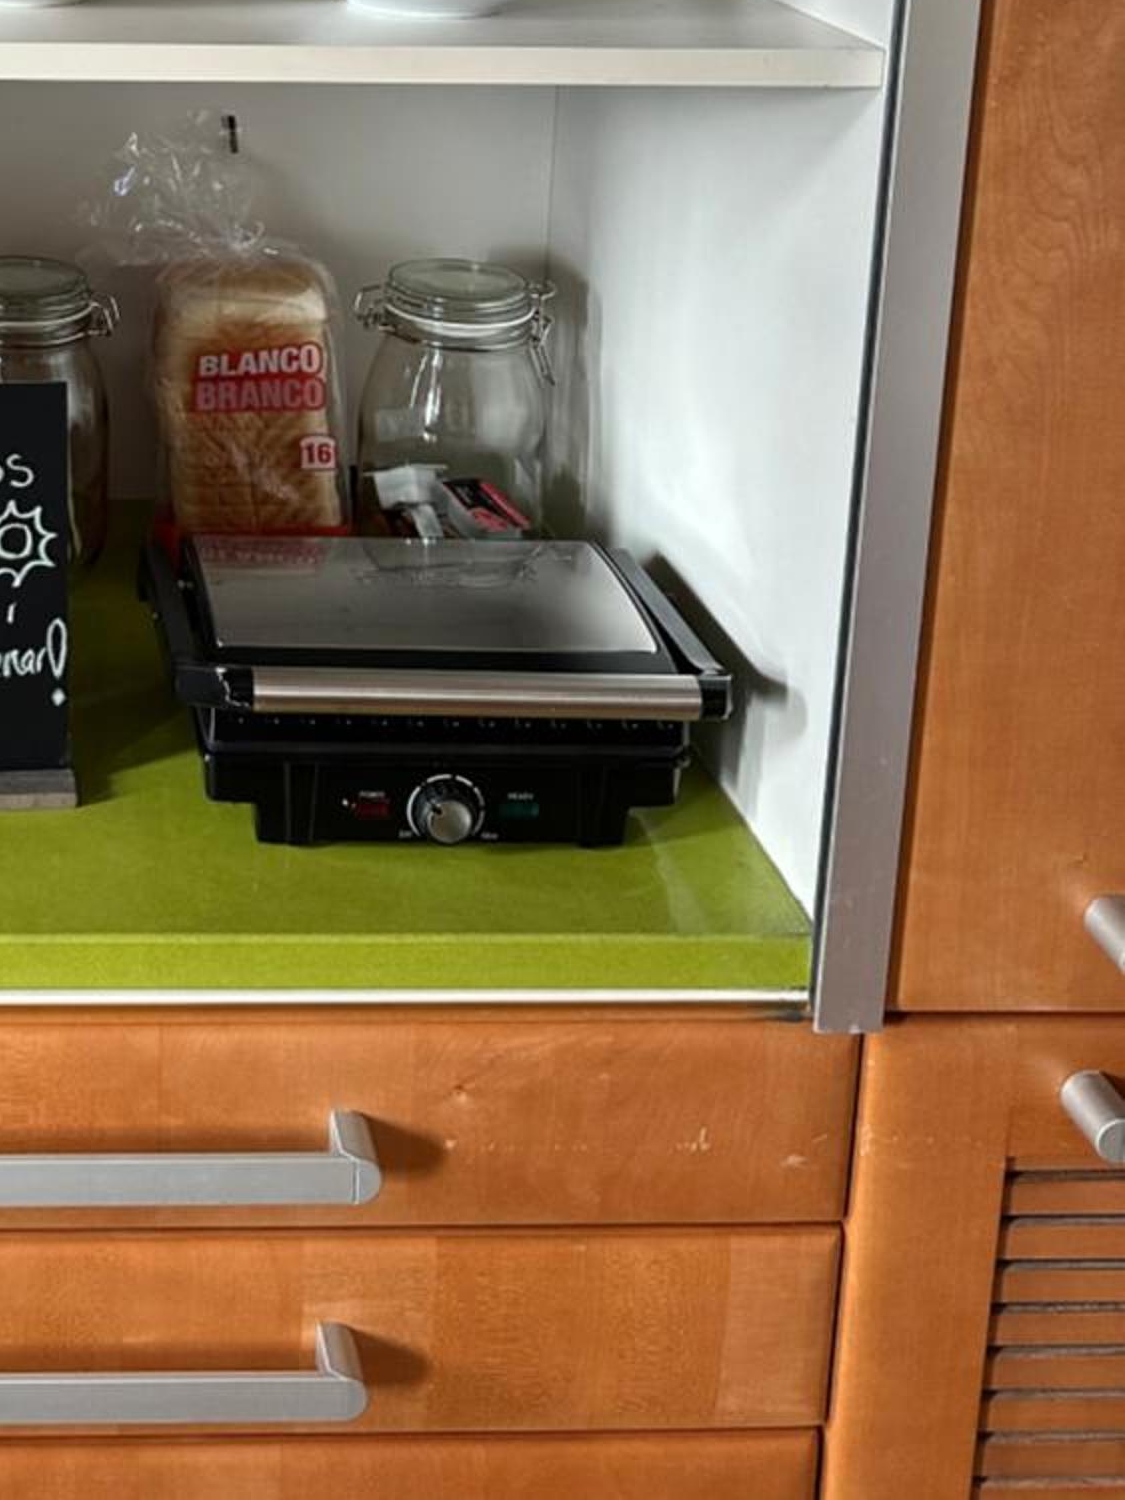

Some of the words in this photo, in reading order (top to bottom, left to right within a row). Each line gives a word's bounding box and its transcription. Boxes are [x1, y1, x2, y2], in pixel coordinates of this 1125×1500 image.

[199, 344, 322, 377] BLANCO
[196, 379, 324, 411] BRANCO
[305, 443, 332, 466] 16
